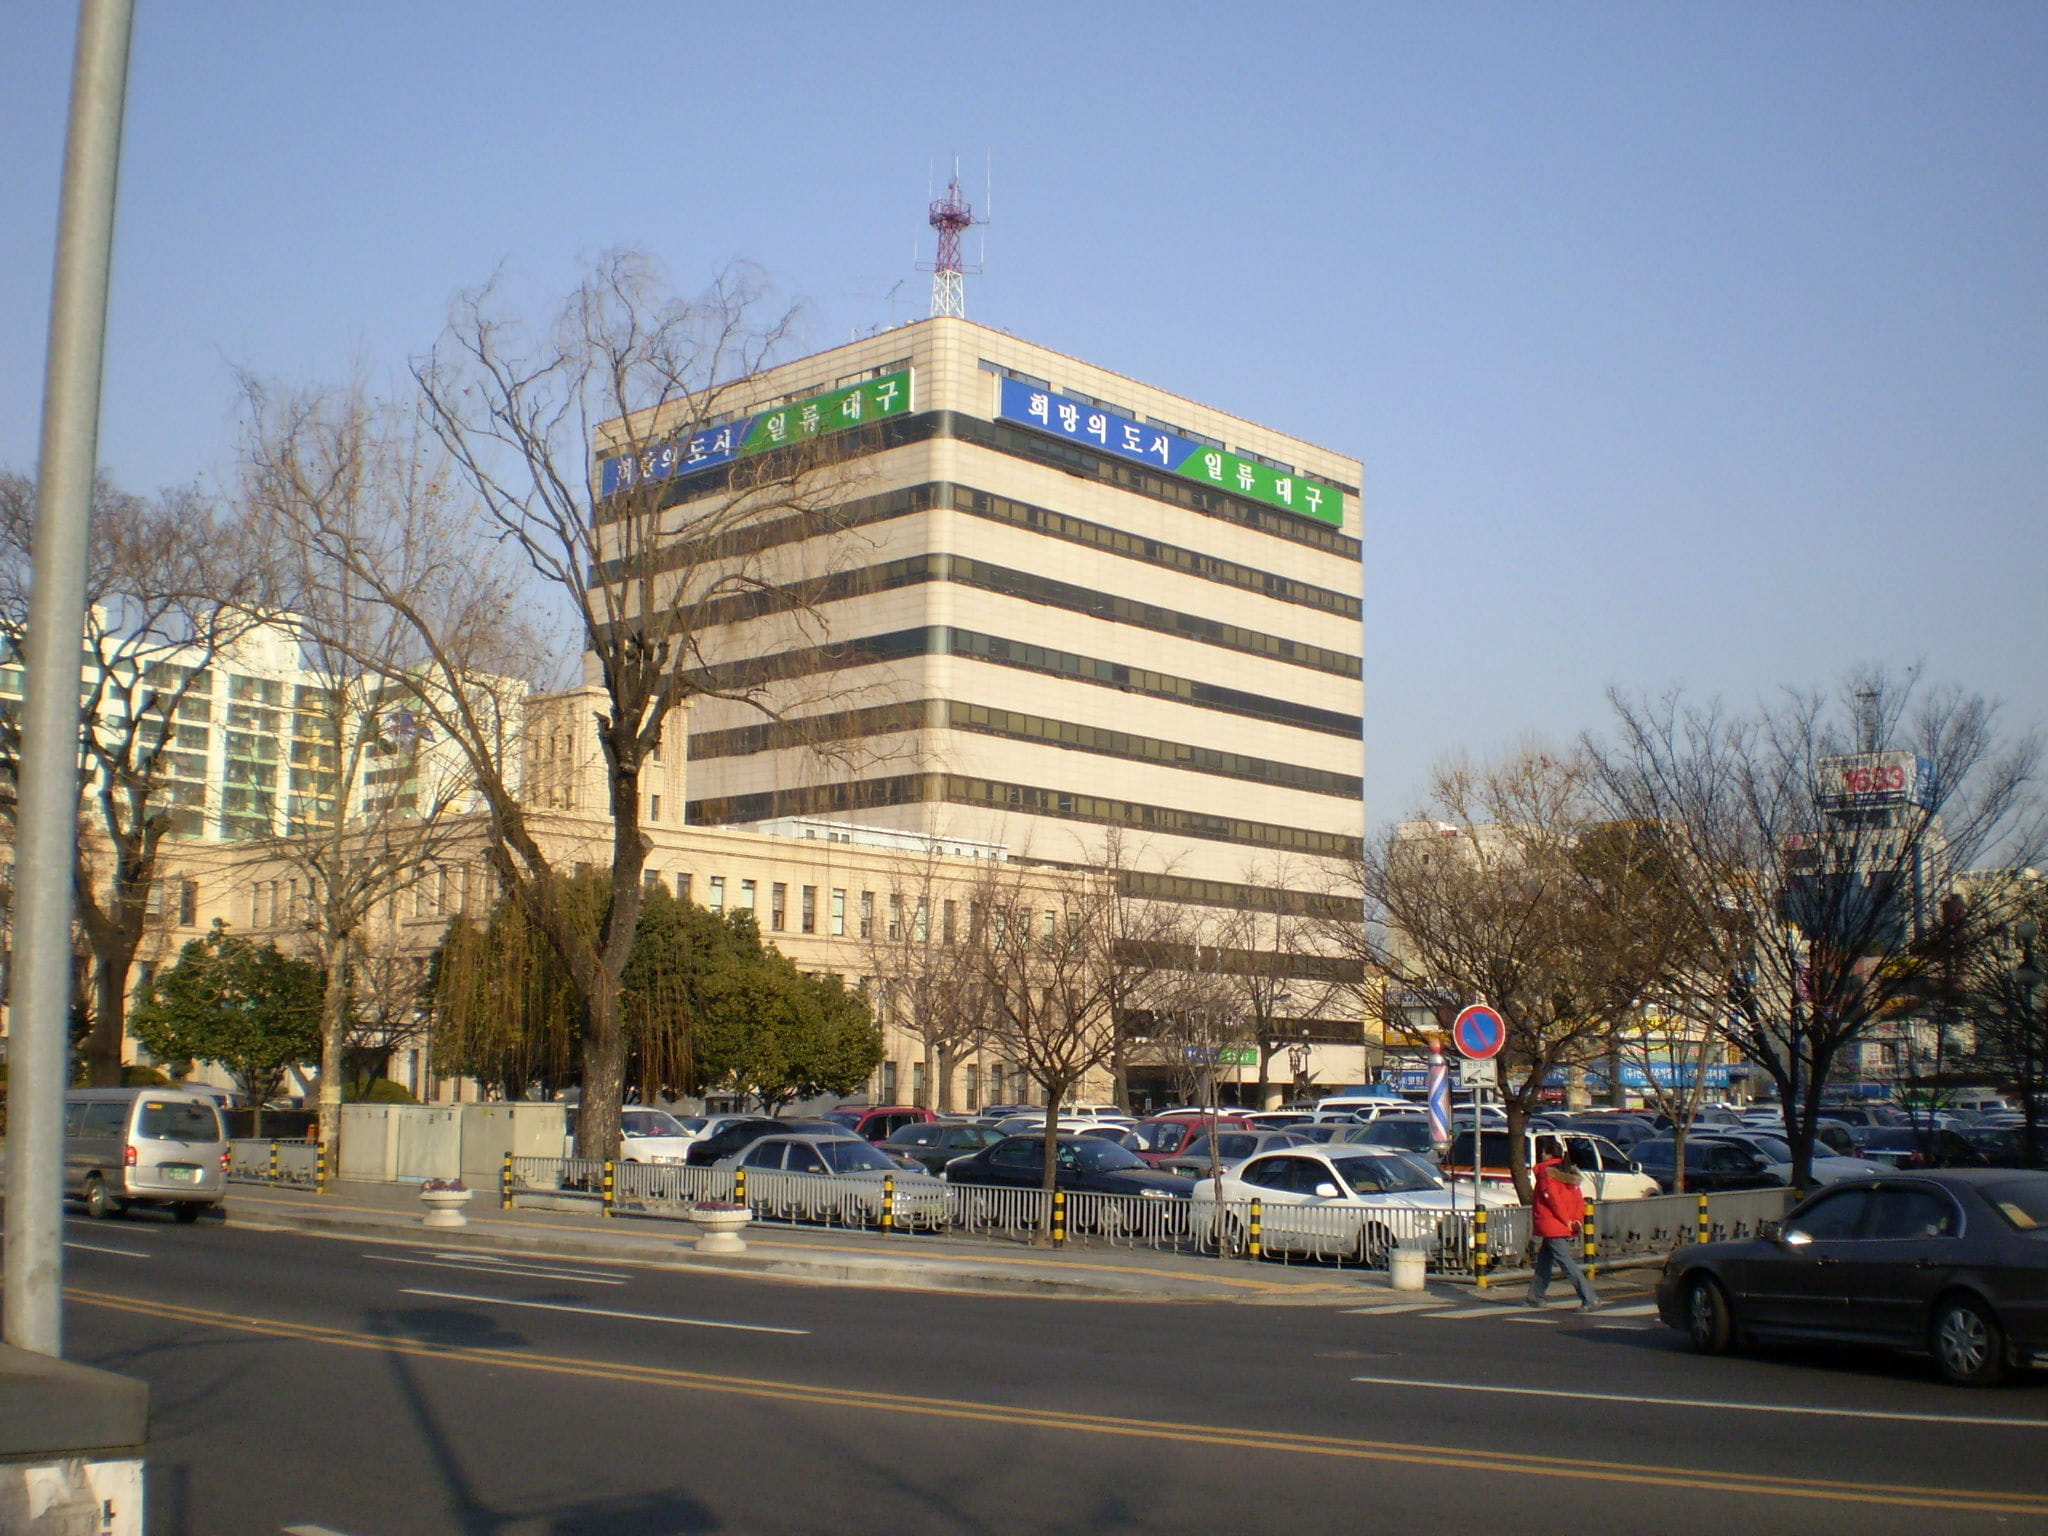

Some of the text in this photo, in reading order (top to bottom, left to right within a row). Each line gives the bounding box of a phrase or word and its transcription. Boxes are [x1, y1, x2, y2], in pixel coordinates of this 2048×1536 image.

[687, 428, 731, 466] 도시
[767, 404, 820, 443] 일류
[841, 380, 899, 421] 대구
[1028, 393, 1324, 513] 희망의 도시 일류 대구
